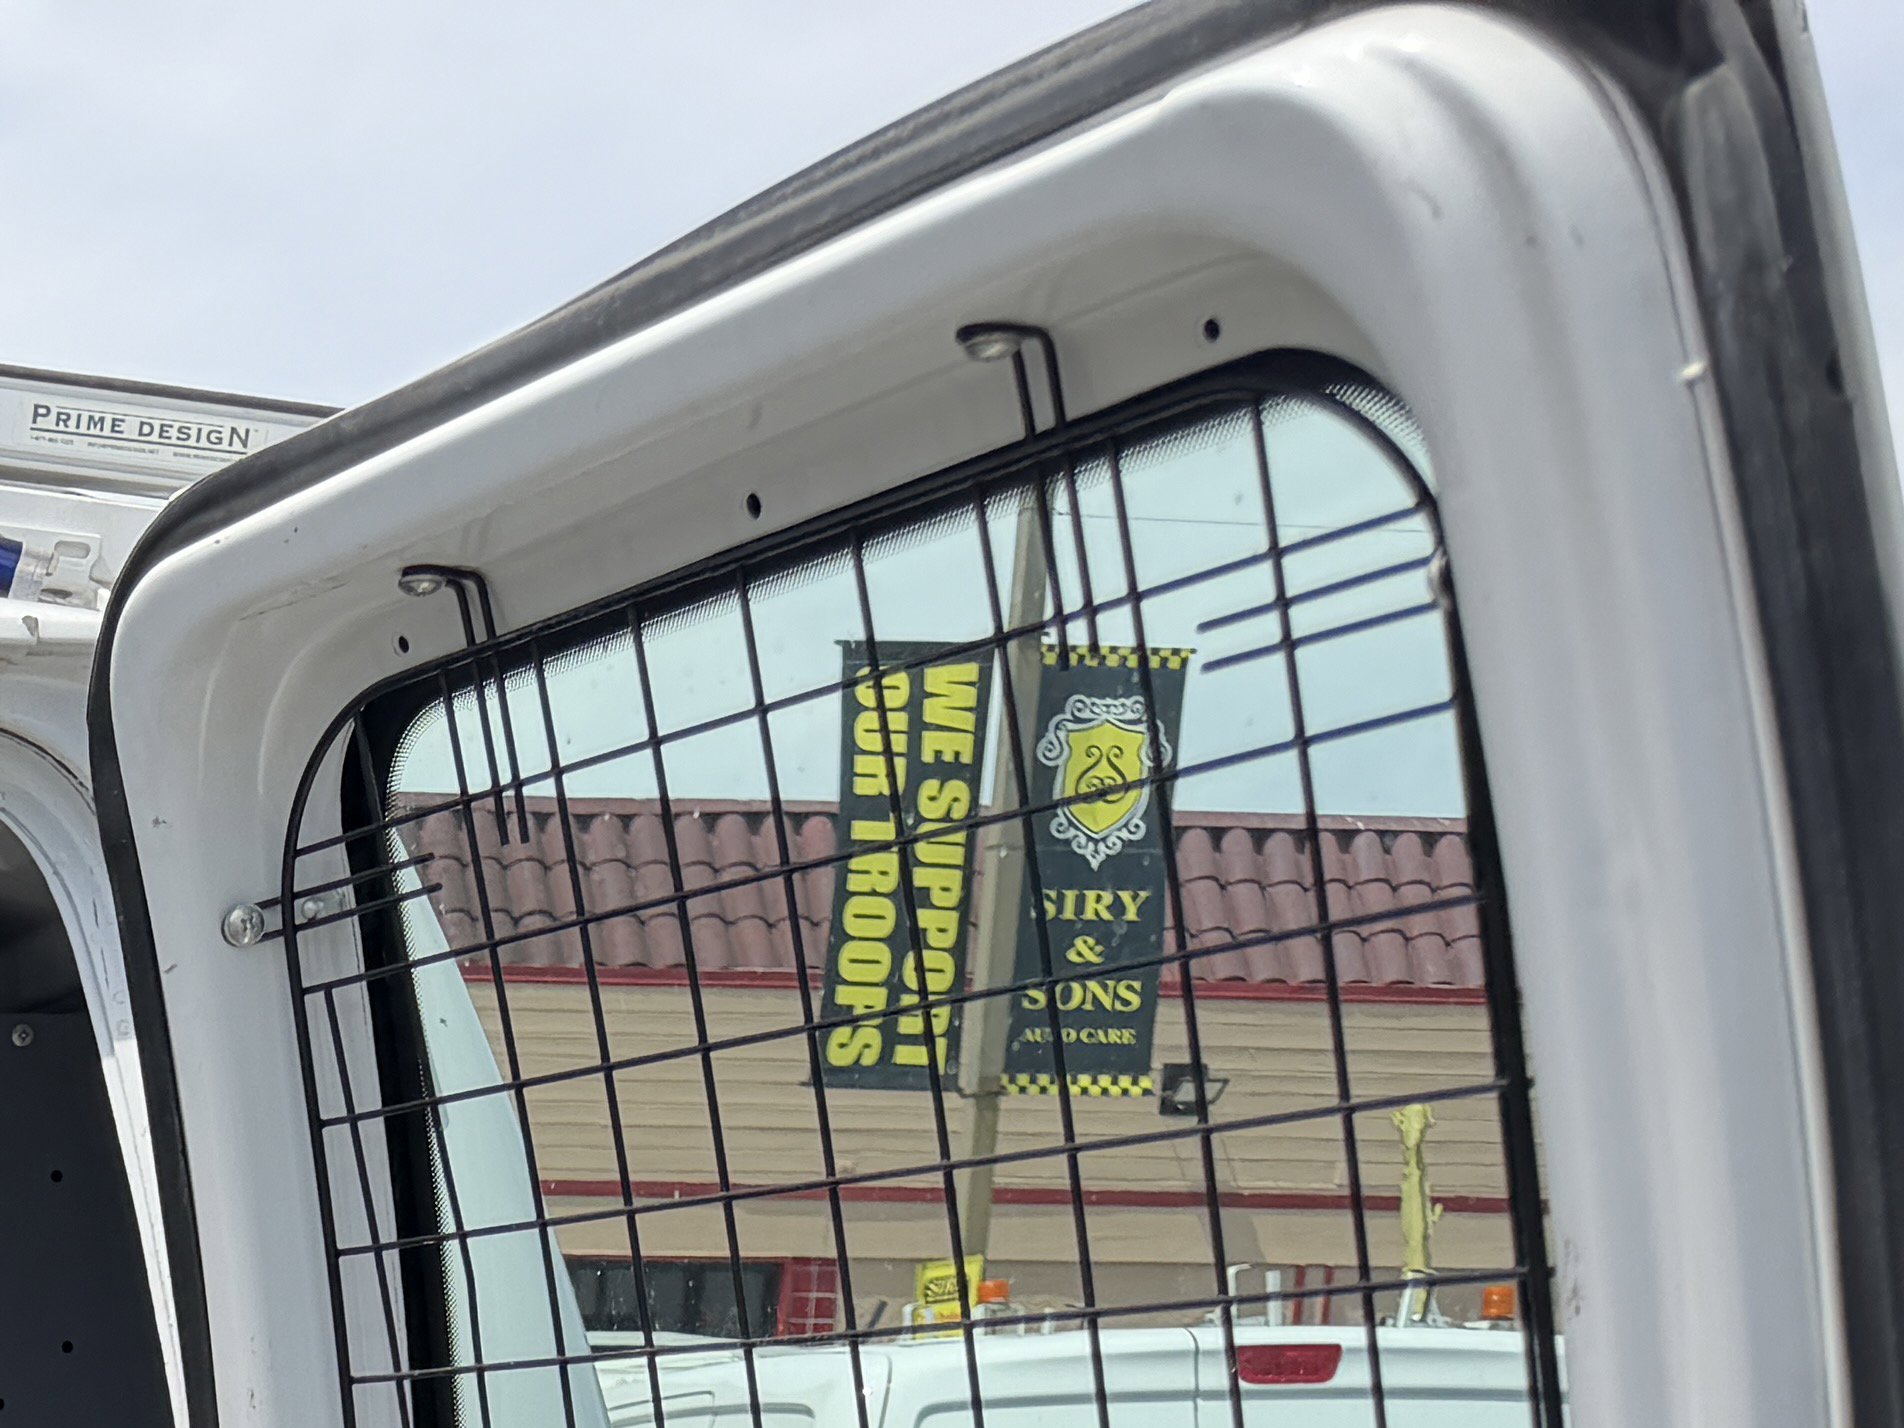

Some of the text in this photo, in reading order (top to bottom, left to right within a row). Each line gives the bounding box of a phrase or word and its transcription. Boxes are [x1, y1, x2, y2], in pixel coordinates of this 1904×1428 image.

[32, 403, 125, 435] PRIME
[138, 420, 250, 449] DESIGN
[825, 665, 910, 1067] OUR TROOPS
[891, 662, 980, 1076] WE SUPPORT
[1032, 889, 1150, 922] SIRY
[1065, 935, 1106, 964] &
[1021, 980, 1142, 1012] SONS
[1019, 1027, 1137, 1045] AUO CARE
